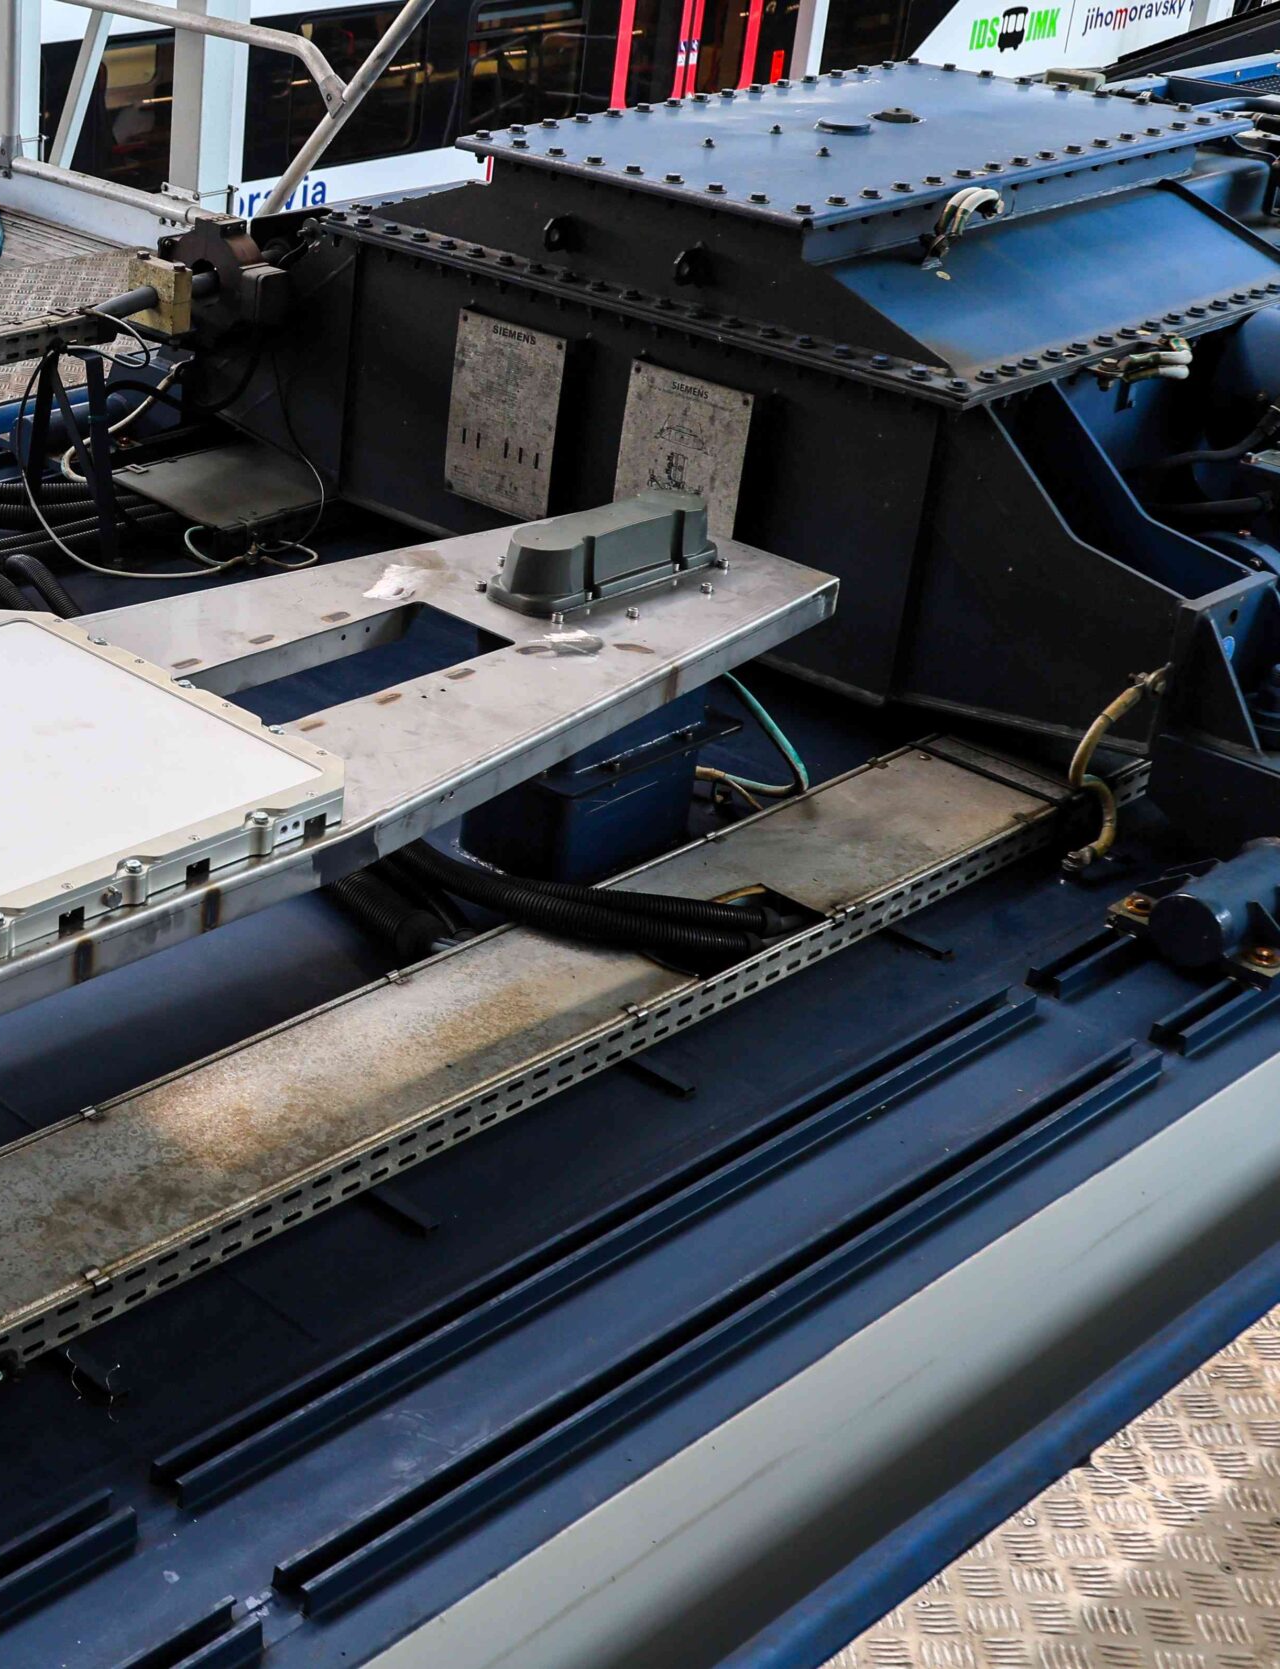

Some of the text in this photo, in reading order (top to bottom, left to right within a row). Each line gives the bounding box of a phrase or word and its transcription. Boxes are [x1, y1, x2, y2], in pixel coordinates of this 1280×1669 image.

[969, 7, 1061, 51] IDS JMK
[492, 324, 537, 346] SIEMENS
[671, 381, 709, 400] SIEMENS
